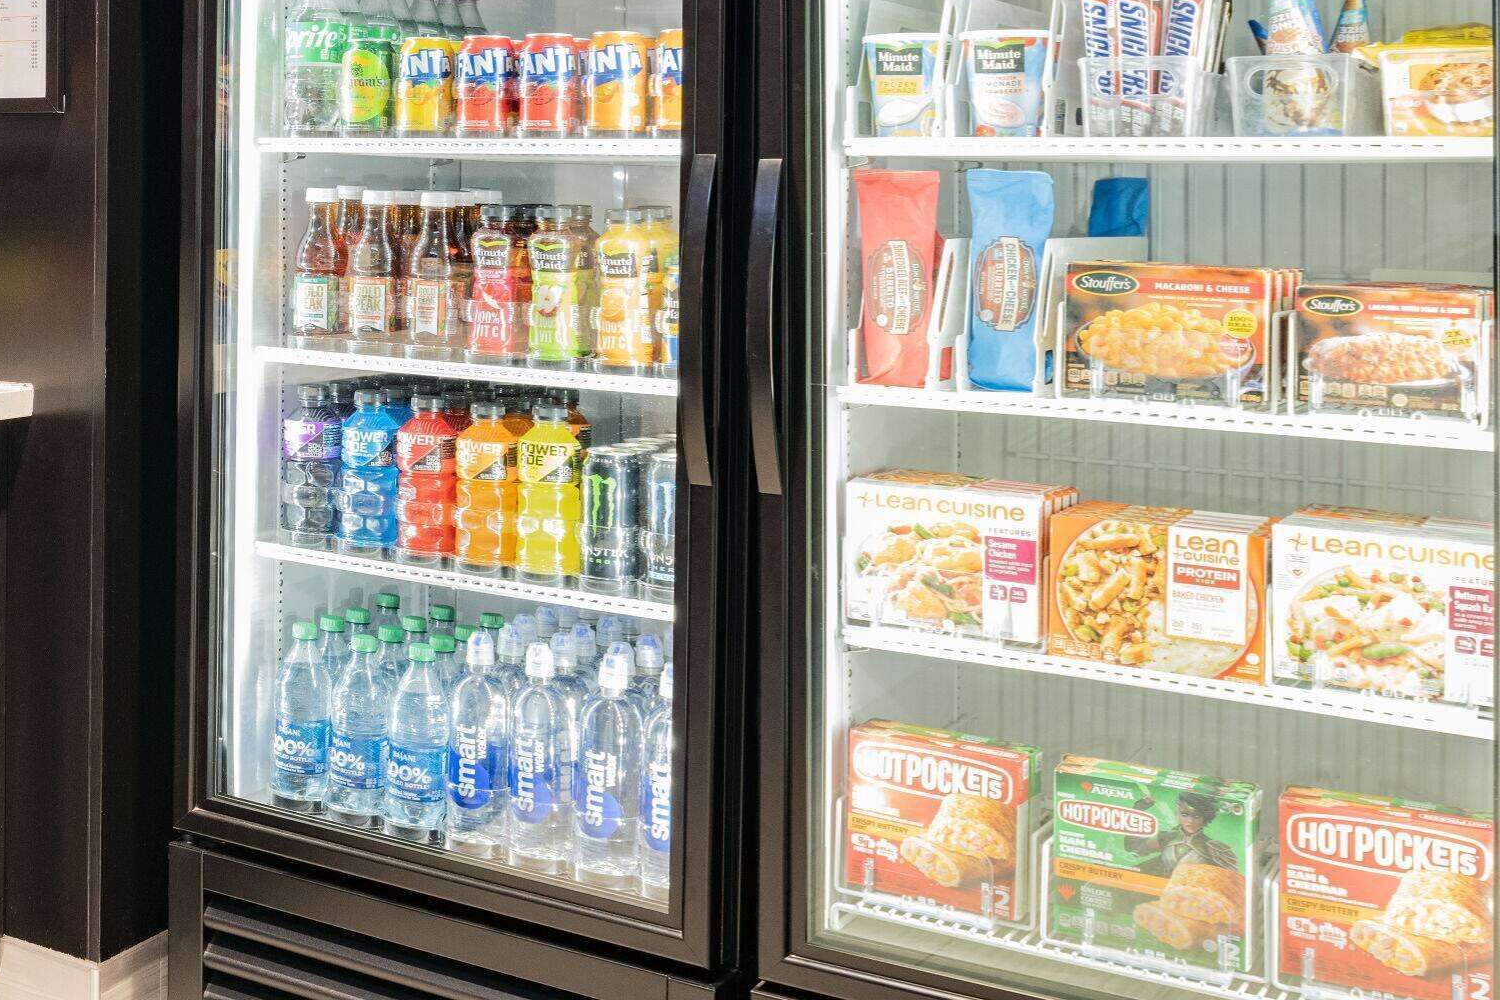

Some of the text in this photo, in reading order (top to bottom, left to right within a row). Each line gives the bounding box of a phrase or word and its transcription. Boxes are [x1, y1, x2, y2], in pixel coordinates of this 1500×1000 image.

[401, 49, 451, 78] ANTA
[878, 51, 920, 63] Minute
[977, 49, 1022, 61] Minute
[982, 59, 1017, 70] Maid
[882, 61, 915, 72] Maid
[886, 266, 895, 309] BURRITO
[994, 262, 1004, 304] BURRITO
[1002, 243, 1018, 325] CHICKEN CHEESE
[1080, 275, 1132, 292] Stouffer's
[1155, 282, 1250, 294] MACARONI CHEESE
[1310, 298, 1357, 313] Stouffer's
[989, 527, 1032, 537] FEATURES
[1175, 534, 1239, 556] Lean
[1176, 567, 1238, 582] PROTEIN
[477, 727, 488, 760] water
[456, 724, 476, 799] smart
[534, 738, 545, 773] water
[515, 729, 536, 812] smart
[606, 752, 618, 787] water
[905, 755, 1004, 800] POCKETS
[585, 750, 607, 827] smart
[1092, 787, 1134, 800] ARENA
[1063, 803, 1153, 834] HOT POCKETS
[1297, 821, 1479, 877] HOT POCKETS
[1059, 861, 1123, 881] CRISPY BUTTERY
[994, 890, 1010, 909] 2
[1287, 897, 1359, 918] CRISPY BUTTERY
